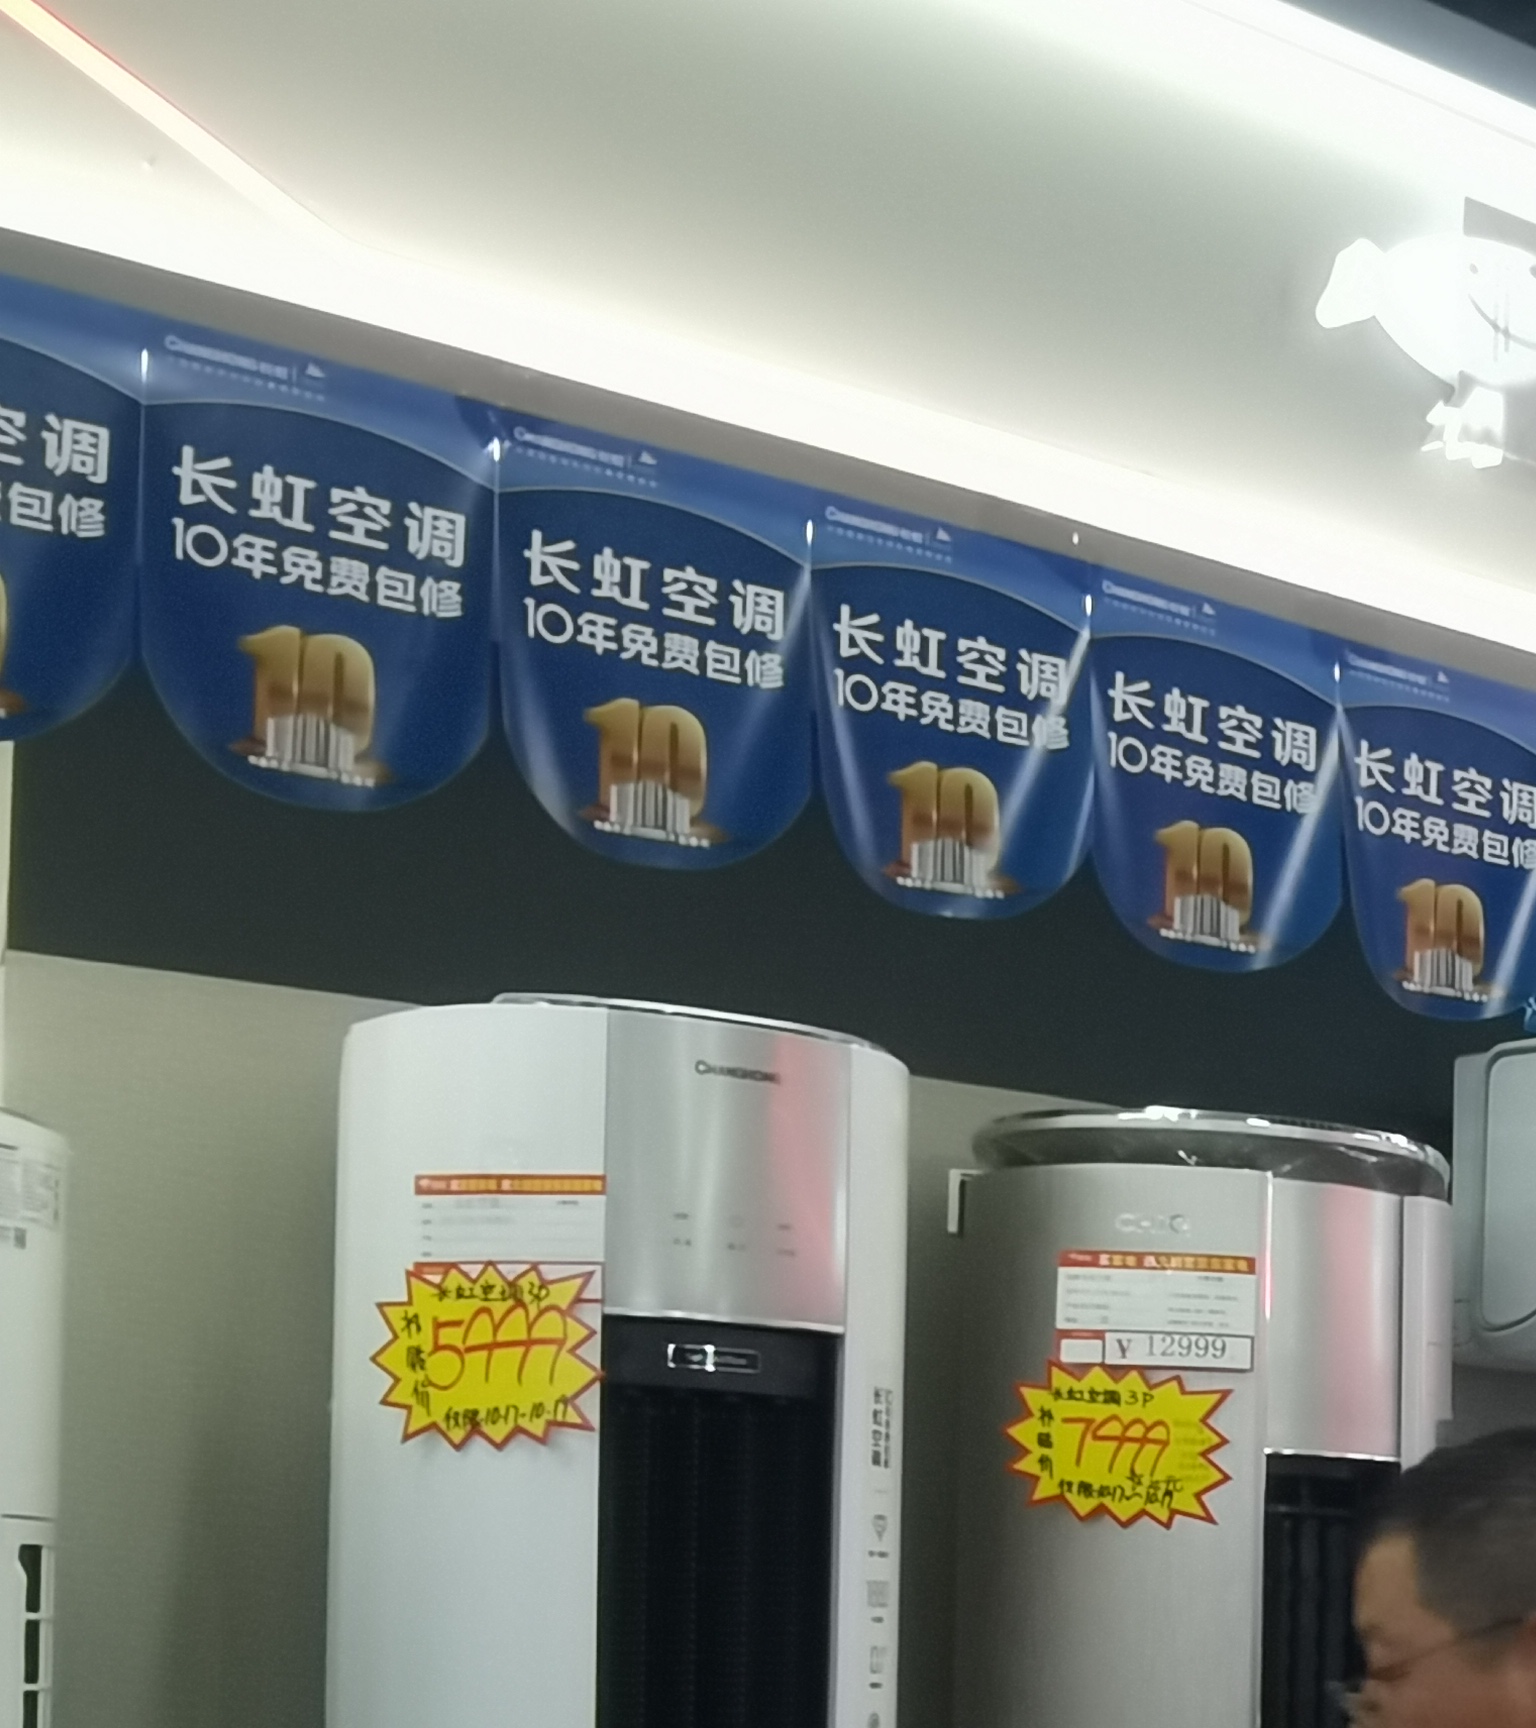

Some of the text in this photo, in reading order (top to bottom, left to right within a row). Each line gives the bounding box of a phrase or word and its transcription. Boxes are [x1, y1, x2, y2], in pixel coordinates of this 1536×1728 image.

[0, 482, 106, 540] 包修
[172, 445, 467, 569] 长虹空调
[172, 516, 463, 620] 10年免费包修
[523, 527, 786, 642] 长虹空调
[523, 596, 785, 690] 10年免费包修
[832, 603, 1070, 704] 长虹空调
[832, 667, 1072, 752] 10年免费包修
[1107, 670, 1319, 774] 长虹空调
[1107, 731, 1318, 817] 10年免费包修
[1147, 1333, 1229, 1361] 12999
[1060, 1413, 1171, 1478] 7999
